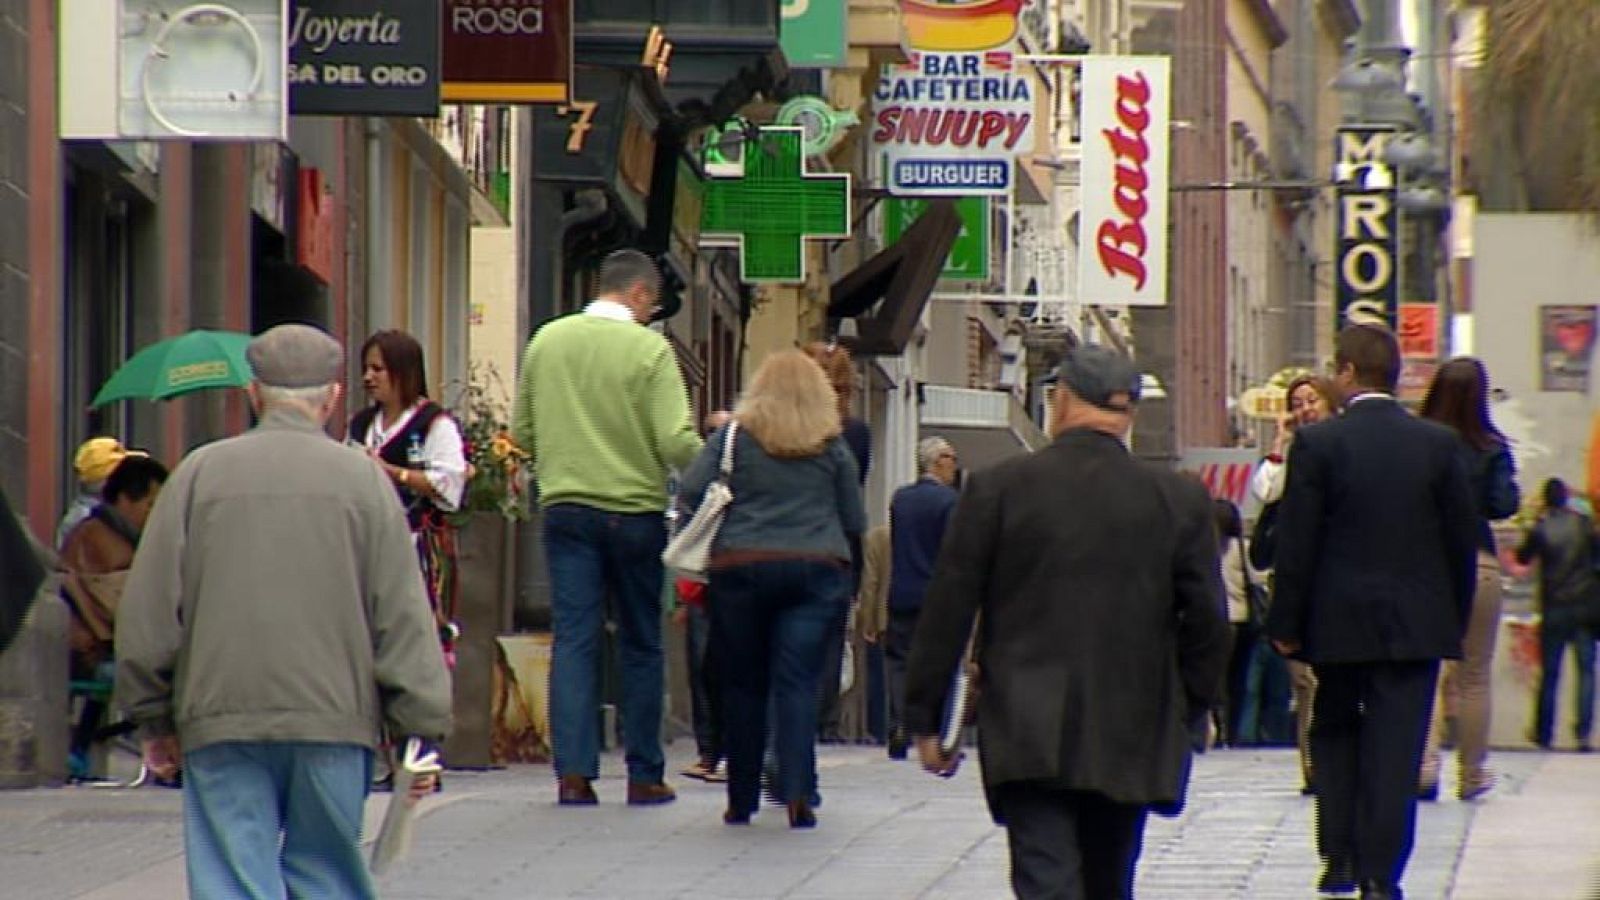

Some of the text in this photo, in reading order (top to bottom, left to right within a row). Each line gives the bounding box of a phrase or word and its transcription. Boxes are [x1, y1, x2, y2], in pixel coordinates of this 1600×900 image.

[324, 65, 365, 84] DEL
[371, 66, 426, 85] ORO
[924, 55, 979, 75] BAR
[875, 74, 1030, 101] CAFETERÍA
[873, 105, 1031, 149] SNUUPY
[901, 164, 1003, 184] BURGUER
[1097, 71, 1150, 292] Bata
